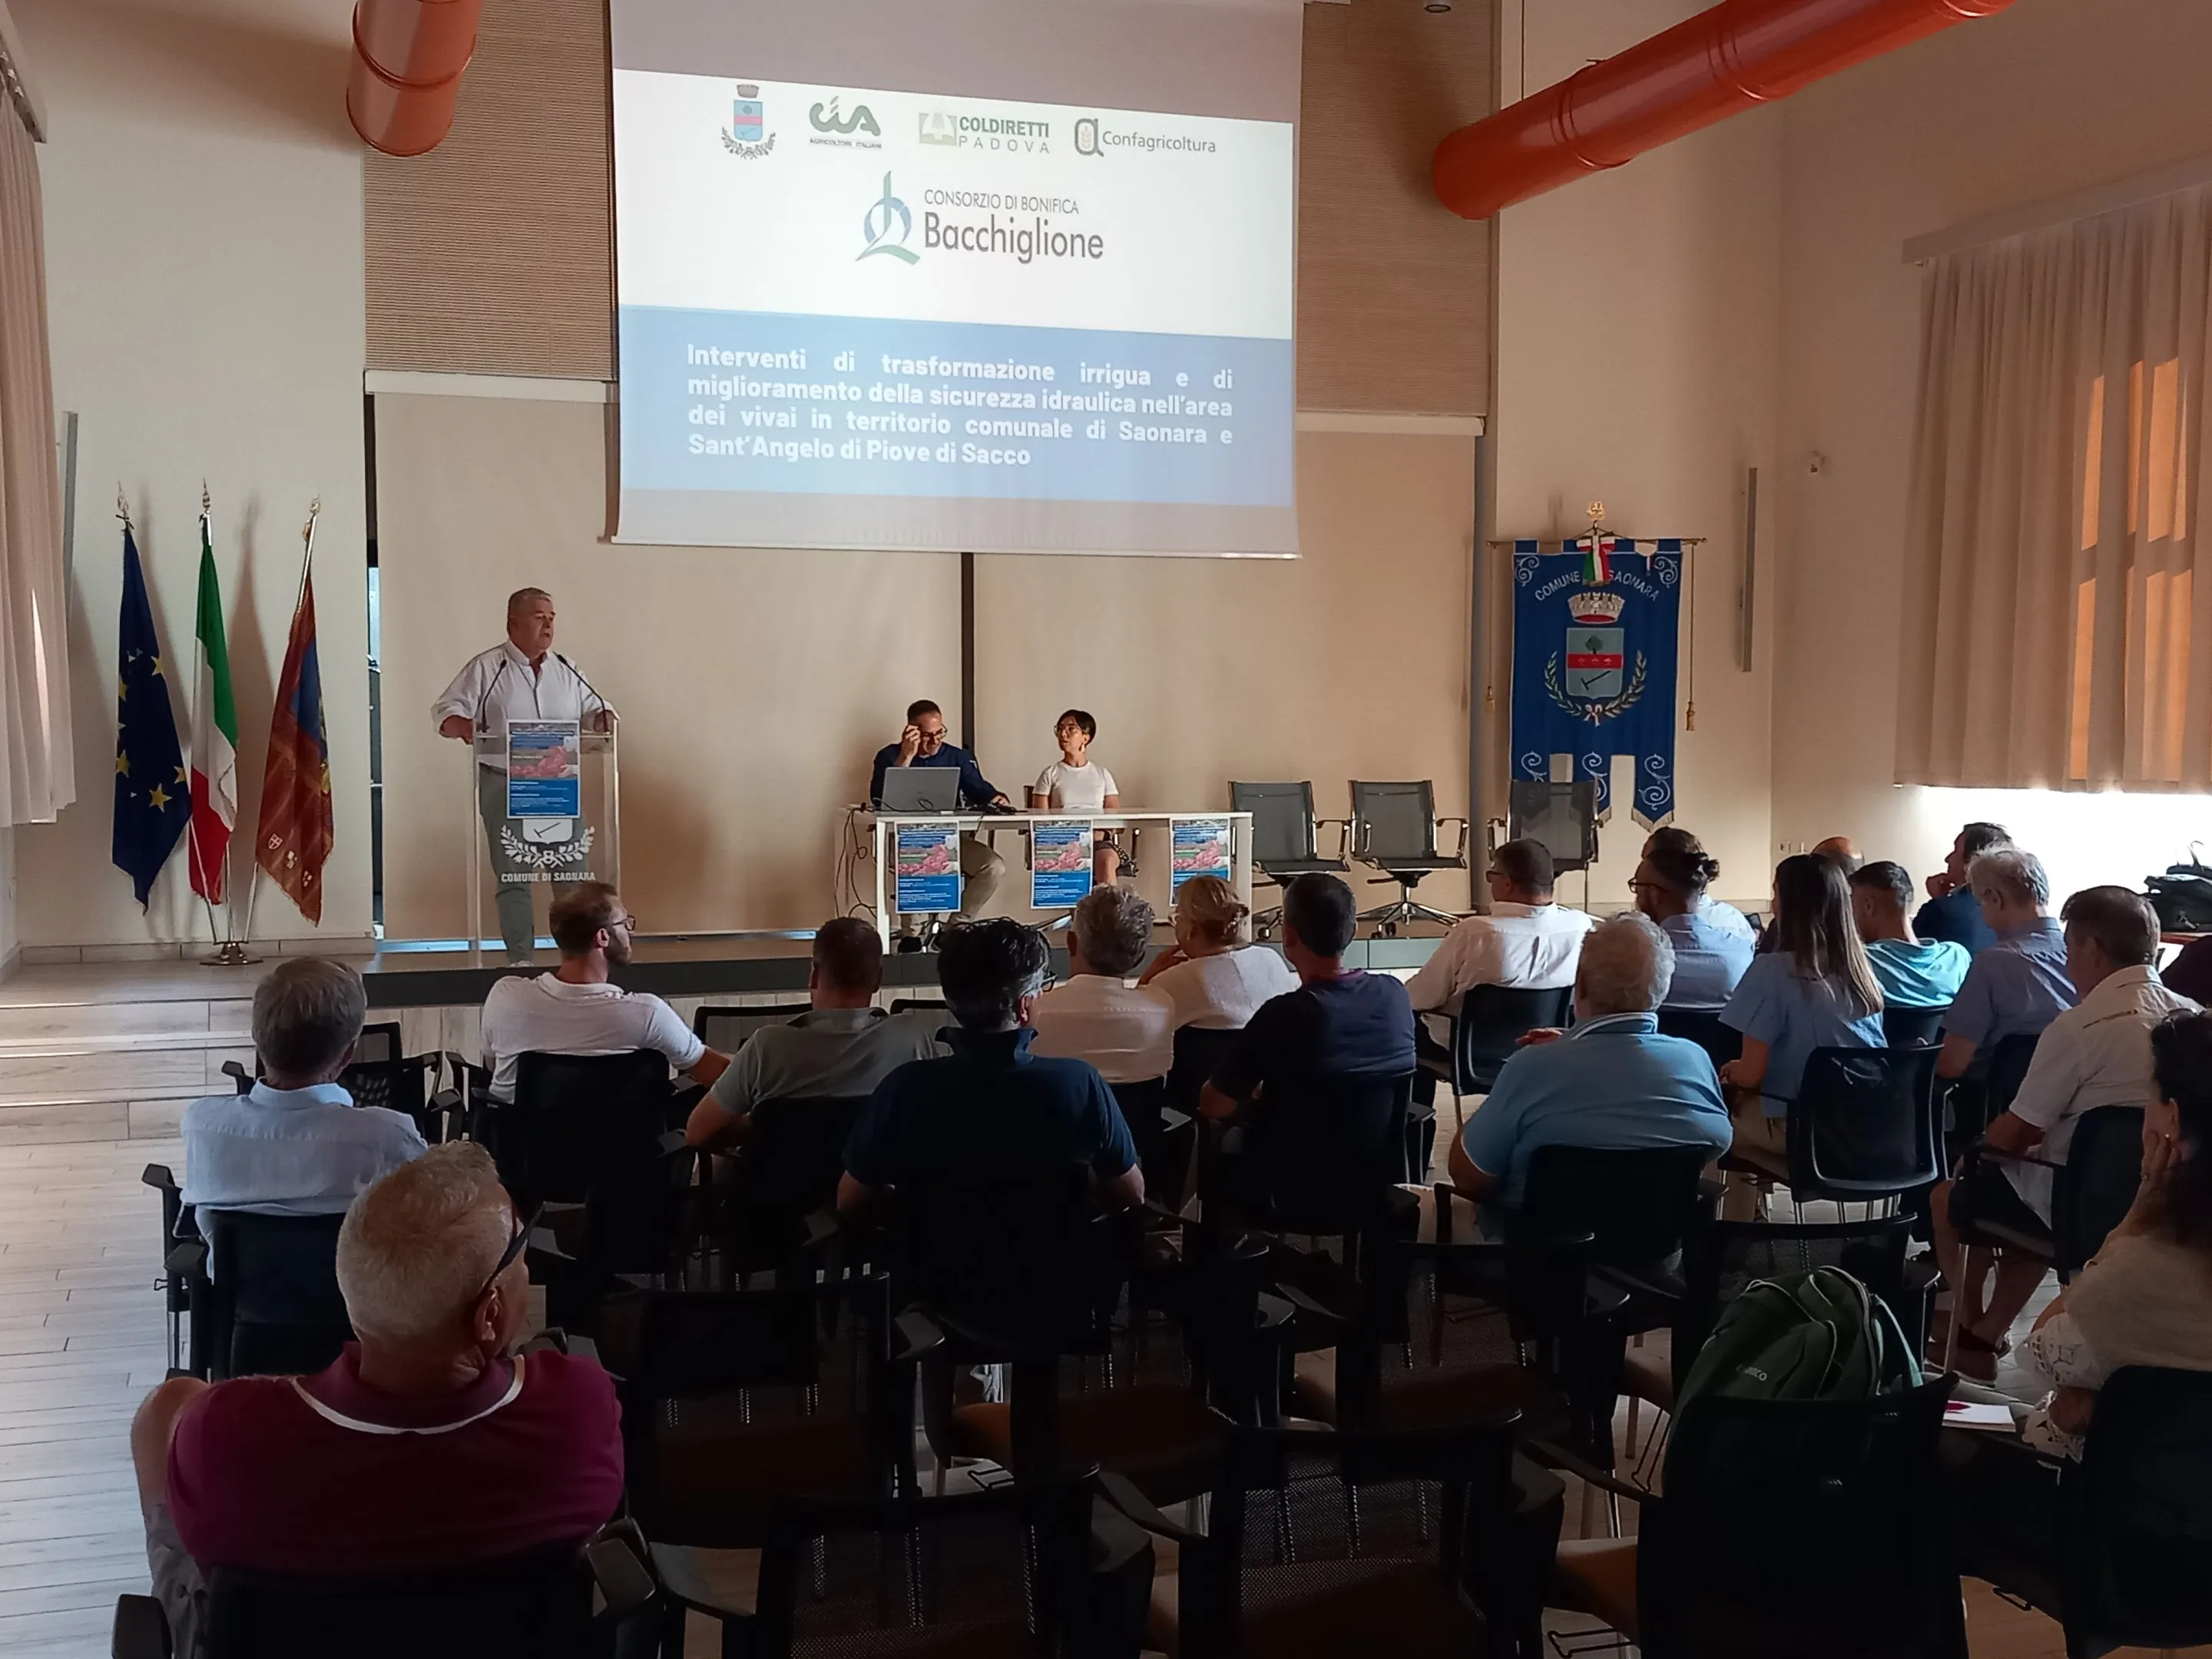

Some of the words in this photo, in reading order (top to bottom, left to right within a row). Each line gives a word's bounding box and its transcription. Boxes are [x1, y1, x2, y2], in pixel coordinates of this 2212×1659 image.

[959, 116, 1050, 138] COLDIRETTI
[958, 136, 1050, 154] PADOVA
[1102, 130, 1217, 154] Confagricoltura
[924, 189, 1002, 210] CONSORZIO
[1005, 194, 1018, 210] DI
[1021, 196, 1080, 215] BONIFICA
[924, 211, 1104, 265] Bacchiglione
[687, 344, 806, 370] Interventi
[833, 351, 856, 373] di
[882, 354, 1055, 382] trasformazione
[1080, 362, 1151, 389] irrigua
[1175, 372, 1189, 388] e
[1213, 369, 1233, 389] di
[687, 374, 863, 402] miglioramento
[868, 382, 924, 405] della
[929, 384, 1036, 409] sicurezza
[1041, 389, 1137, 413] idraulica
[1141, 394, 1233, 417] nell'area
[688, 404, 726, 426] dei
[740, 406, 797, 429] vivai
[811, 408, 833, 429] in
[846, 410, 952, 435] territorio
[965, 418, 1073, 439] comunale
[1085, 419, 1107, 440] di
[1118, 421, 1208, 444] Saonara
[1220, 429, 1233, 445] e
[840, 437, 862, 460] di
[866, 439, 930, 462] Piove
[935, 442, 957, 463] di
[961, 442, 1031, 465] Sacco
[1535, 571, 1582, 601] COMUNE
[501, 873, 540, 883] COMUNE
[541, 873, 552, 882] DI
[552, 872, 597, 882] SAONARA
